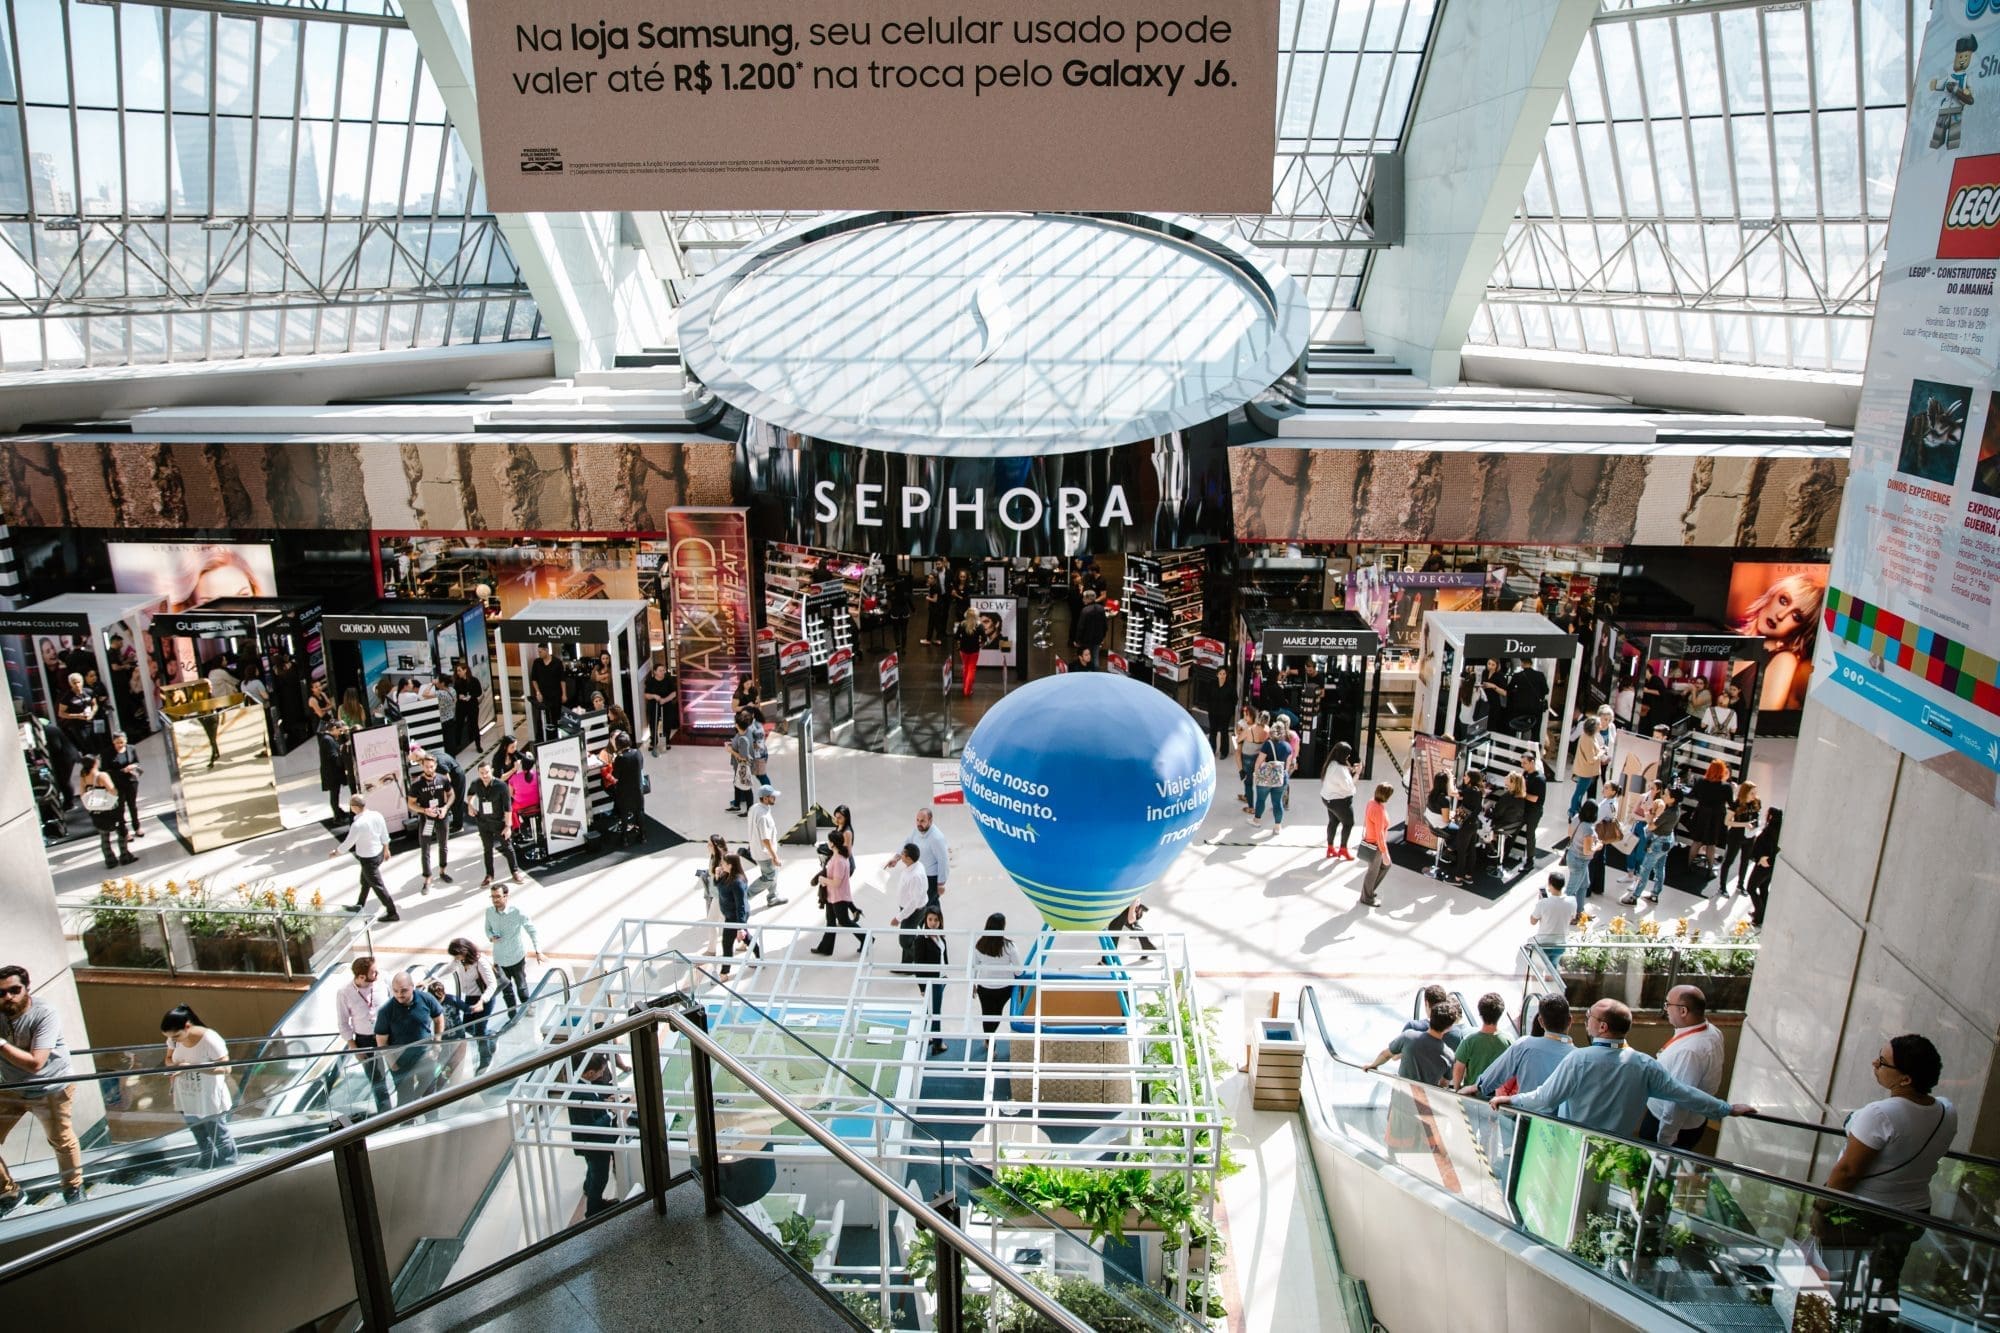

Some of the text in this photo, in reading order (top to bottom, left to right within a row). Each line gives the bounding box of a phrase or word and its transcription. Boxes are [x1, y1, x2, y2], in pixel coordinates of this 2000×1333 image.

[515, 15, 1232, 60] Na loja Samsung, seu celular usado pode
[512, 66, 598, 95] valer
[607, 61, 665, 93] até
[673, 60, 712, 95] R$
[813, 65, 858, 89] na
[868, 59, 964, 88] troca
[975, 59, 1052, 96] pelo
[1062, 58, 1185, 97] Galaxy
[1194, 58, 1238, 88] J6.
[1937, 267, 1997, 280] CONSTRUTORES
[1947, 281, 1994, 296] DO AMANHÃ
[1887, 478, 1952, 506] DINOS EXPERIENCE
[814, 480, 1134, 531] SEPHORA
[1964, 516, 1996, 536] GUERRA
[1419, 575, 1464, 585] DECAY
[975, 601, 1011, 610] LOEWE
[340, 623, 411, 635] GIORGIO ARMANI
[528, 624, 581, 636] LANCÔME
[673, 537, 725, 713] NAKED
[1282, 636, 1358, 646] MAKE UP FOR EVER
[1504, 639, 1537, 653] Dior
[974, 759, 1002, 783] sobre
[1003, 773, 1050, 798] nosso
[1155, 775, 1191, 798] Viaje
[972, 776, 1057, 822] loteamento.
[1147, 792, 1197, 822] incrível
